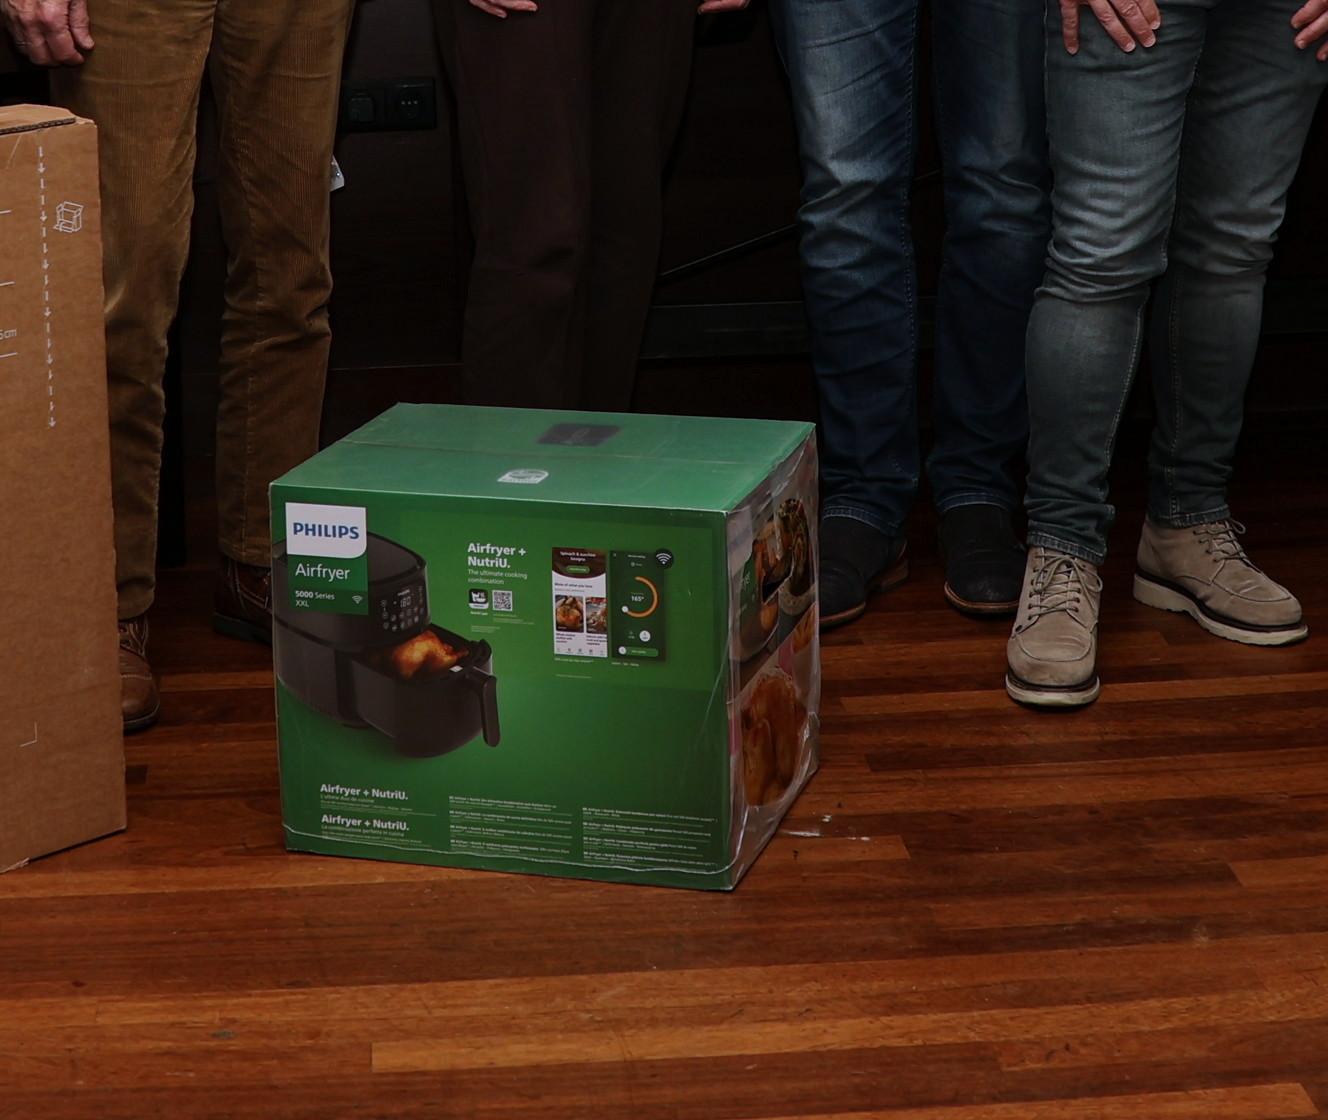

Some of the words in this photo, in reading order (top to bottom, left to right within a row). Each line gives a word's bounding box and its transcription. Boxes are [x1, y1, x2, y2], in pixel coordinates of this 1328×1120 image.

[292, 522, 360, 540] PHILIPS
[467, 542, 516, 557] Airfryer
[467, 555, 511, 569] NutriU.
[295, 562, 350, 582] Airfryer
[295, 590, 314, 599] 5000
[314, 591, 335, 600] Series
[320, 783, 361, 797] Airfryer
[321, 814, 362, 828] Airfryer
